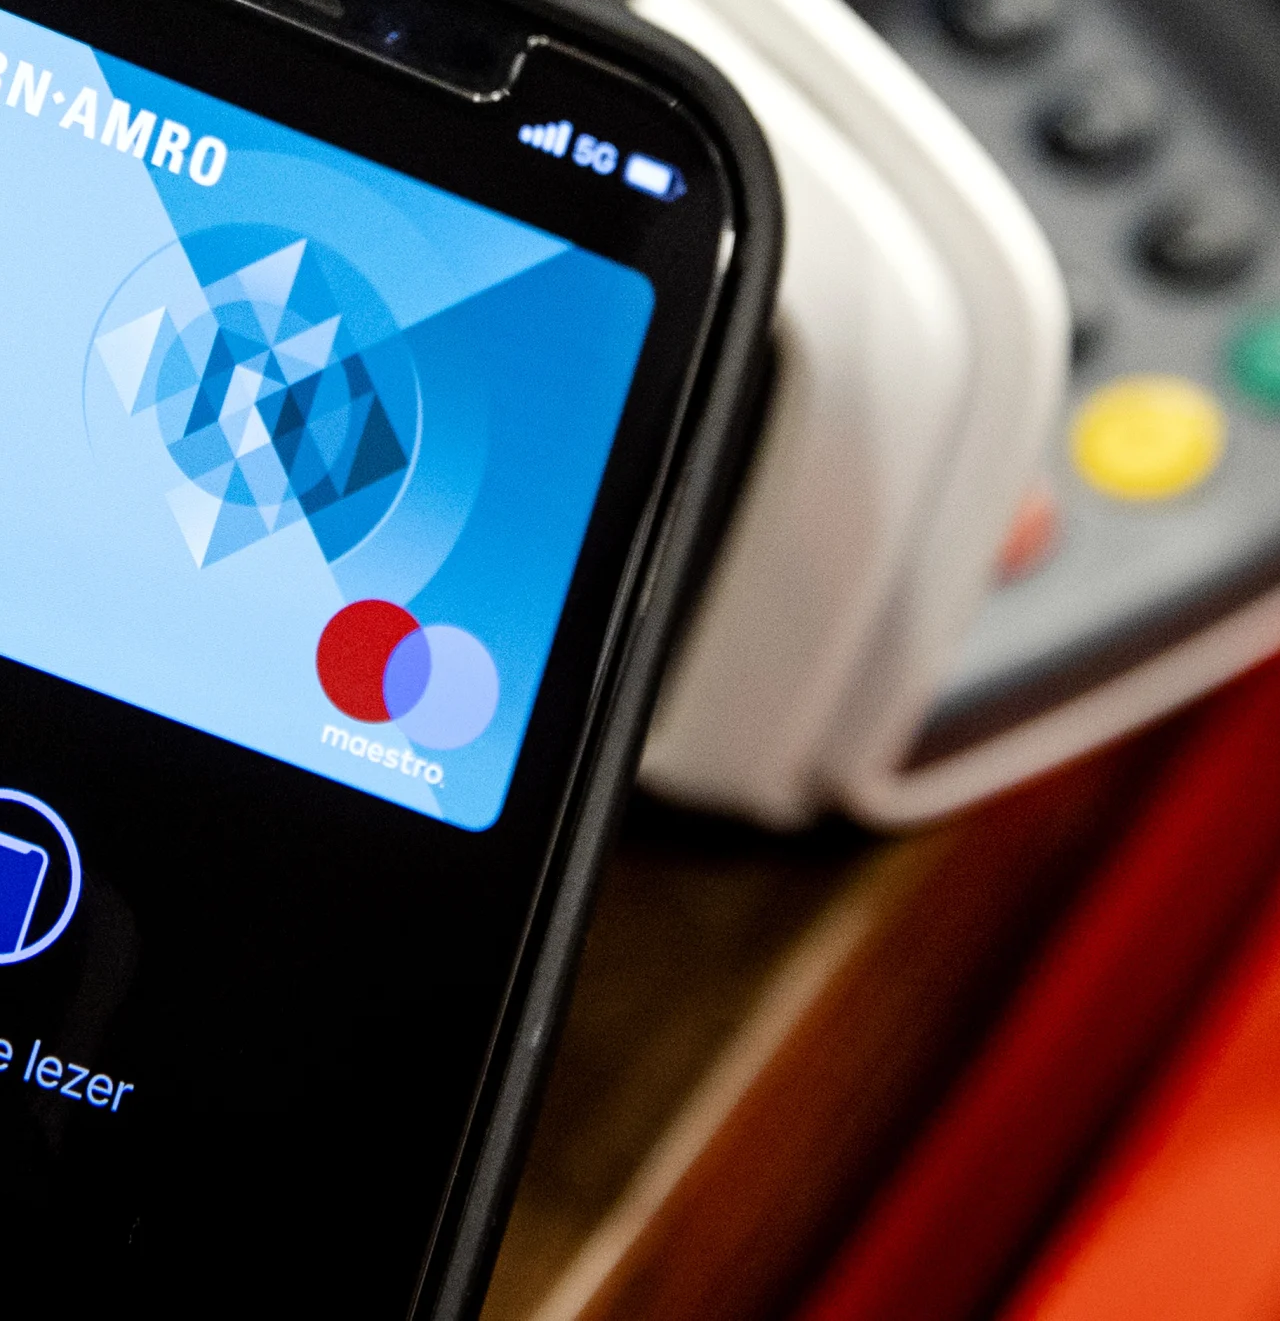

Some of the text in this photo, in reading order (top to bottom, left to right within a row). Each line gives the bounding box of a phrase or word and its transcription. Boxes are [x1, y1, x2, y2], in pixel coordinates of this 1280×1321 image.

[573, 133, 619, 175] 5G
[321, 723, 445, 788] maestro
[23, 1040, 134, 1112] lezer
